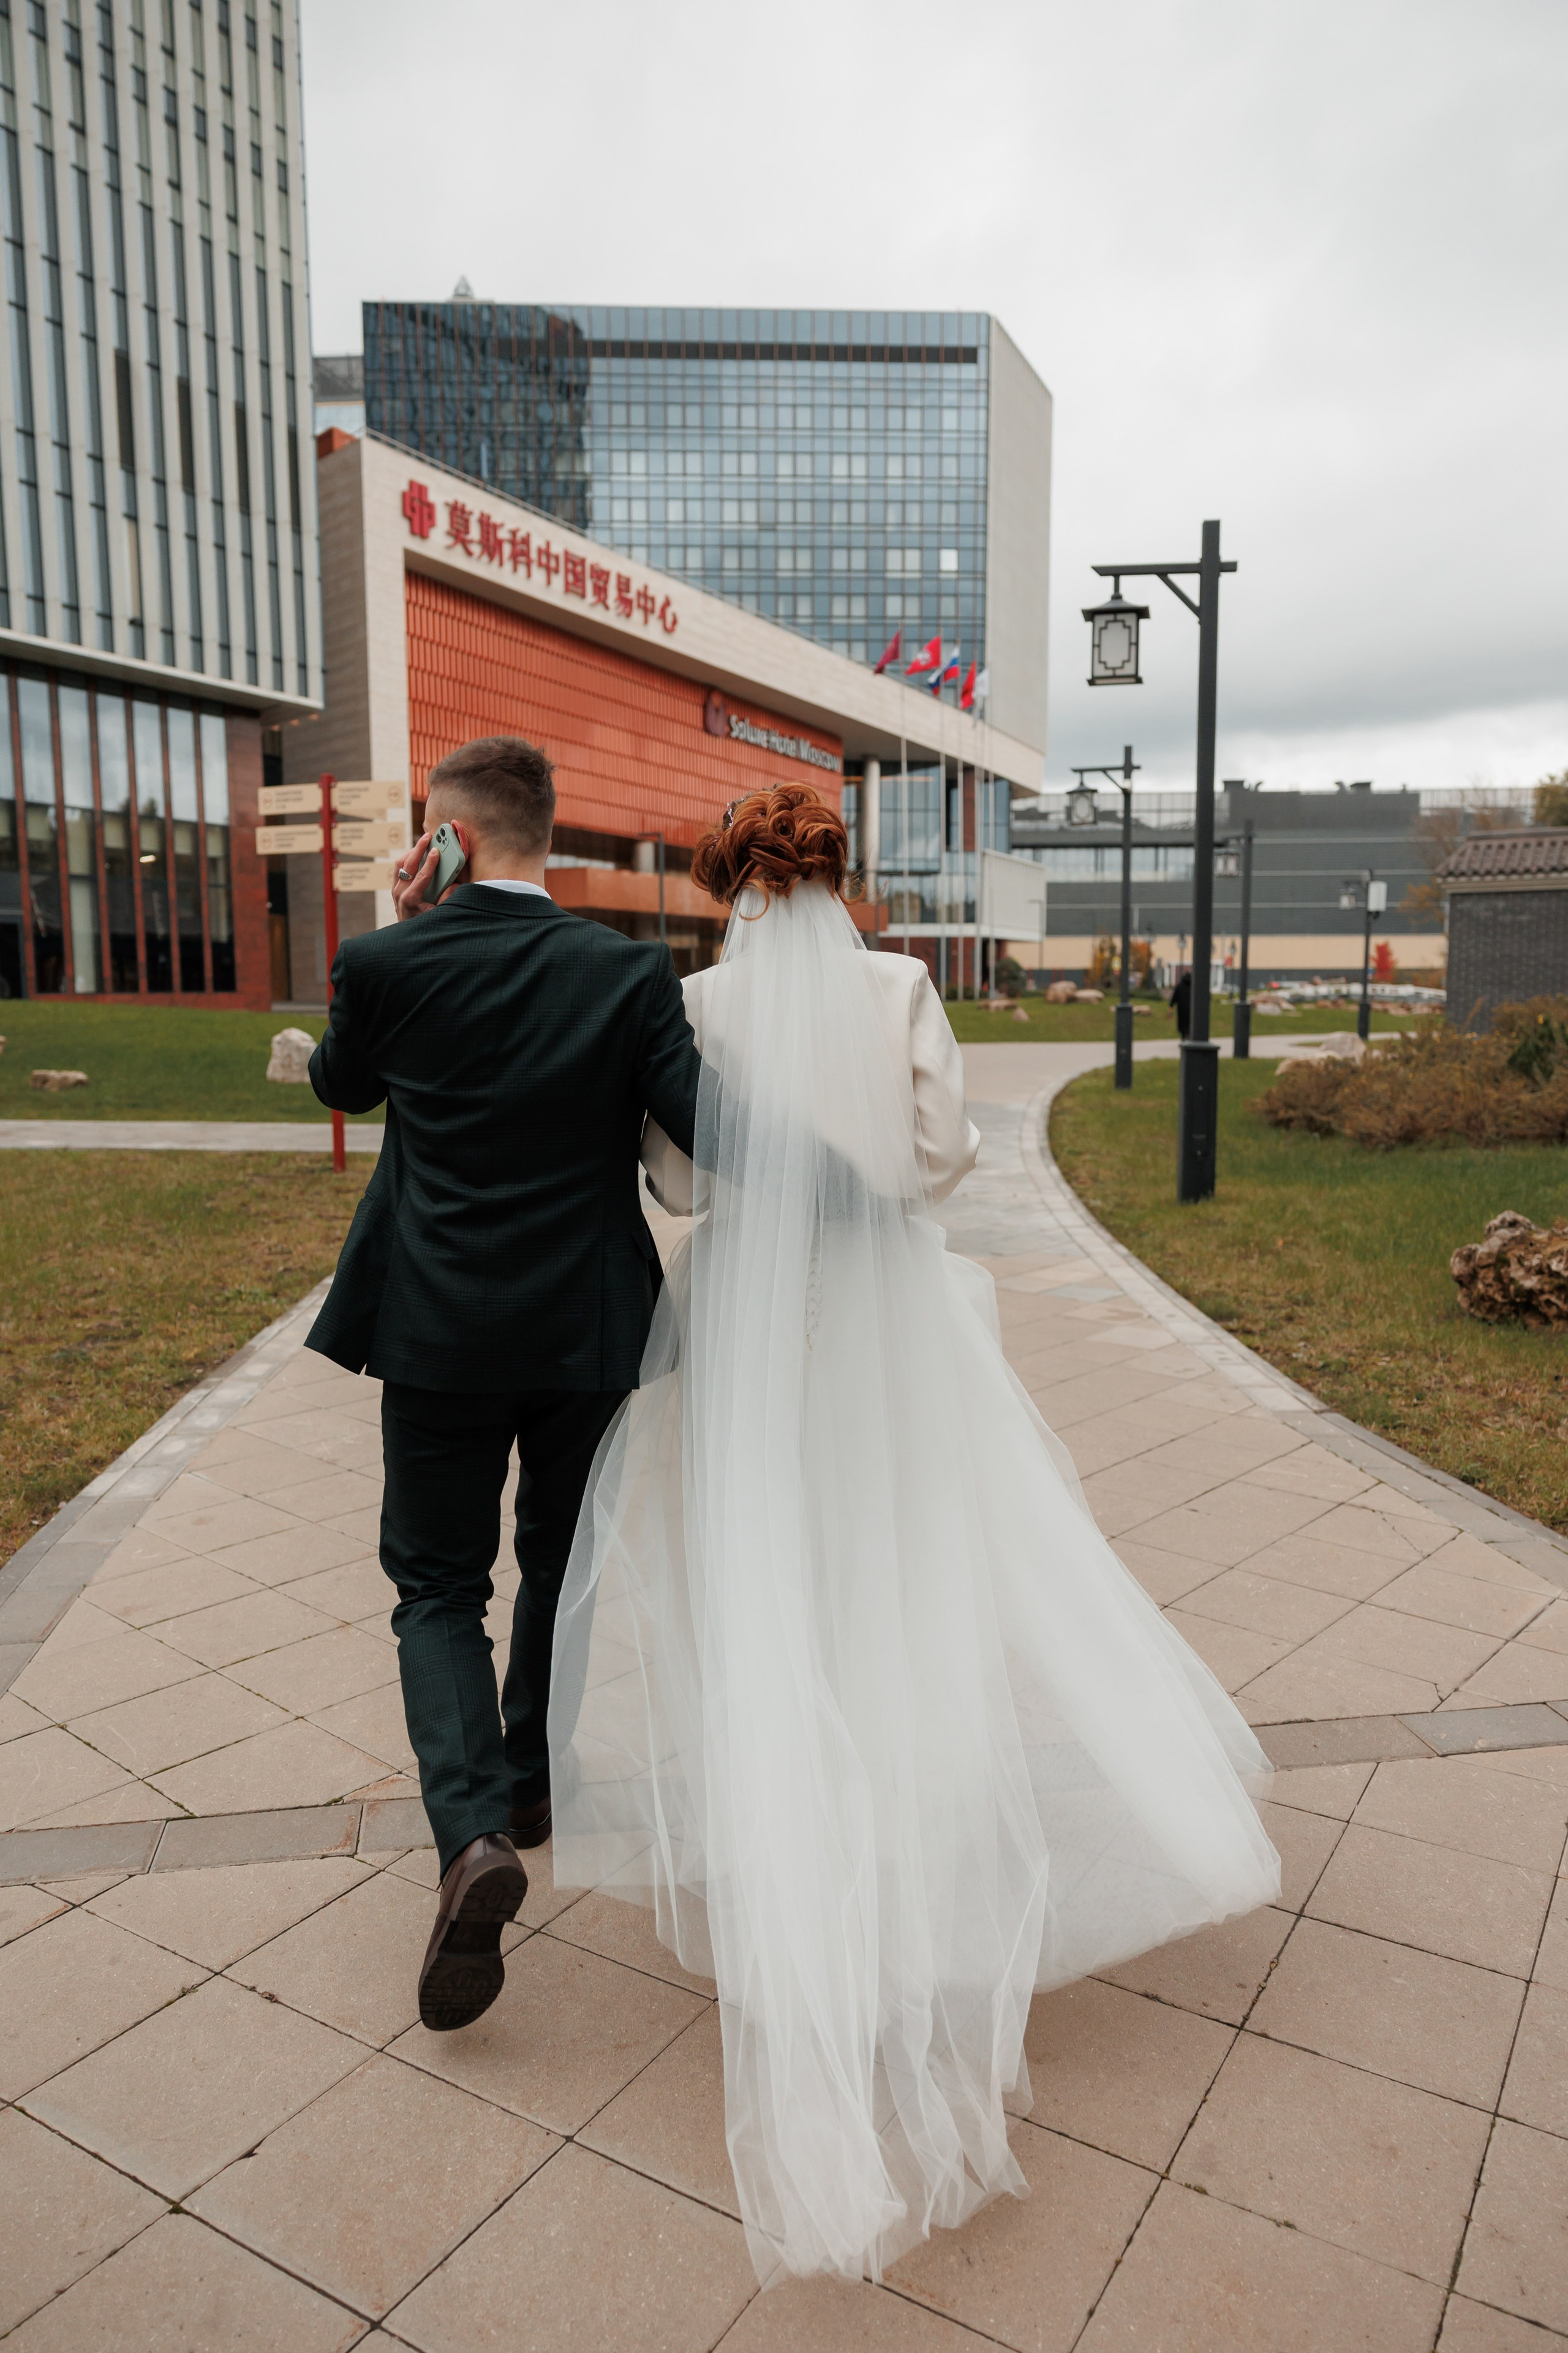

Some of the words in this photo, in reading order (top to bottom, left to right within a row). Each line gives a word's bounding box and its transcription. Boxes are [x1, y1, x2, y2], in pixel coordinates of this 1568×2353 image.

[445, 499, 678, 633] 莫斯科中国贸易中心
